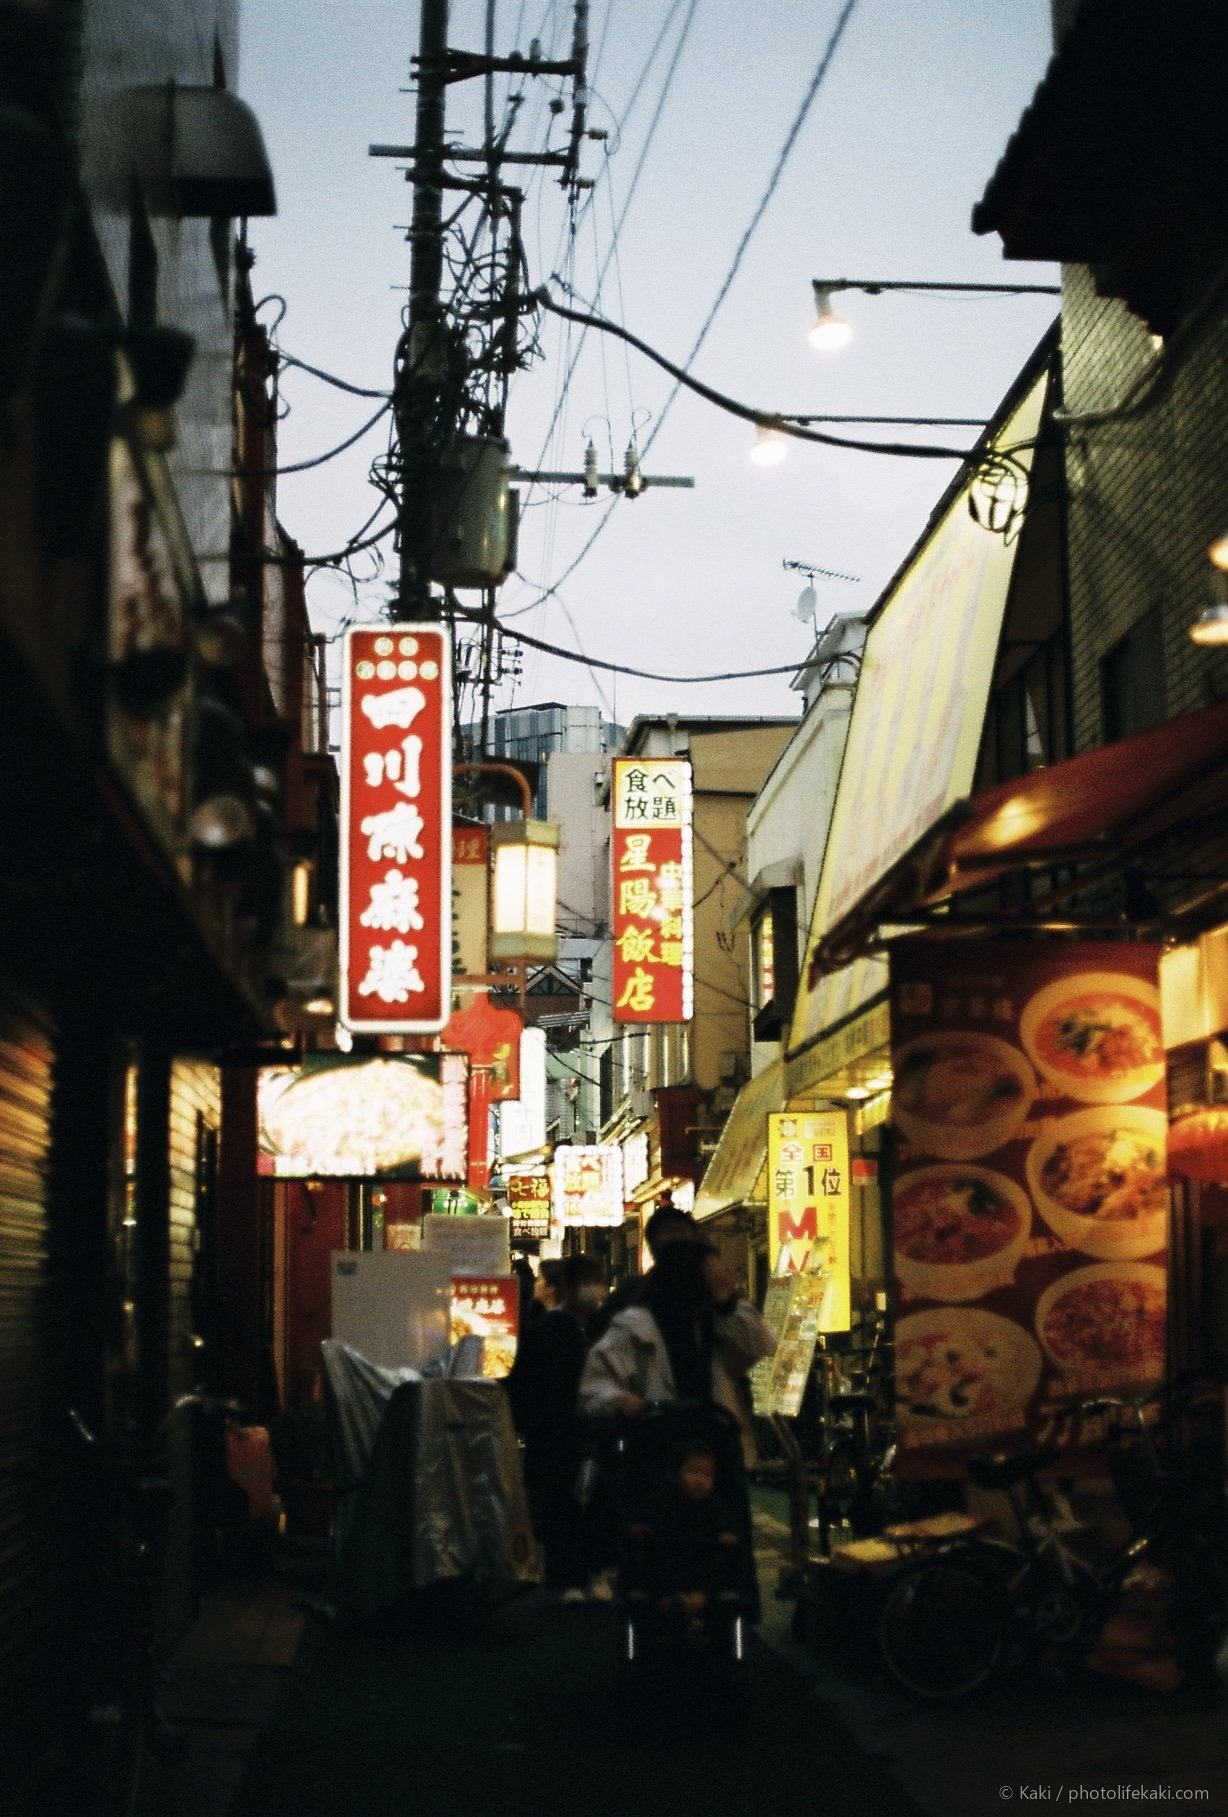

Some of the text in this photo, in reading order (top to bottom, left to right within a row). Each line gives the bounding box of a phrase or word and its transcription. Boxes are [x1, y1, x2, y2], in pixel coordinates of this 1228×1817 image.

[616, 834, 661, 1013] 星陽飯店
[781, 1143, 833, 1162] 全国
[775, 1165, 842, 1198] 第1位
